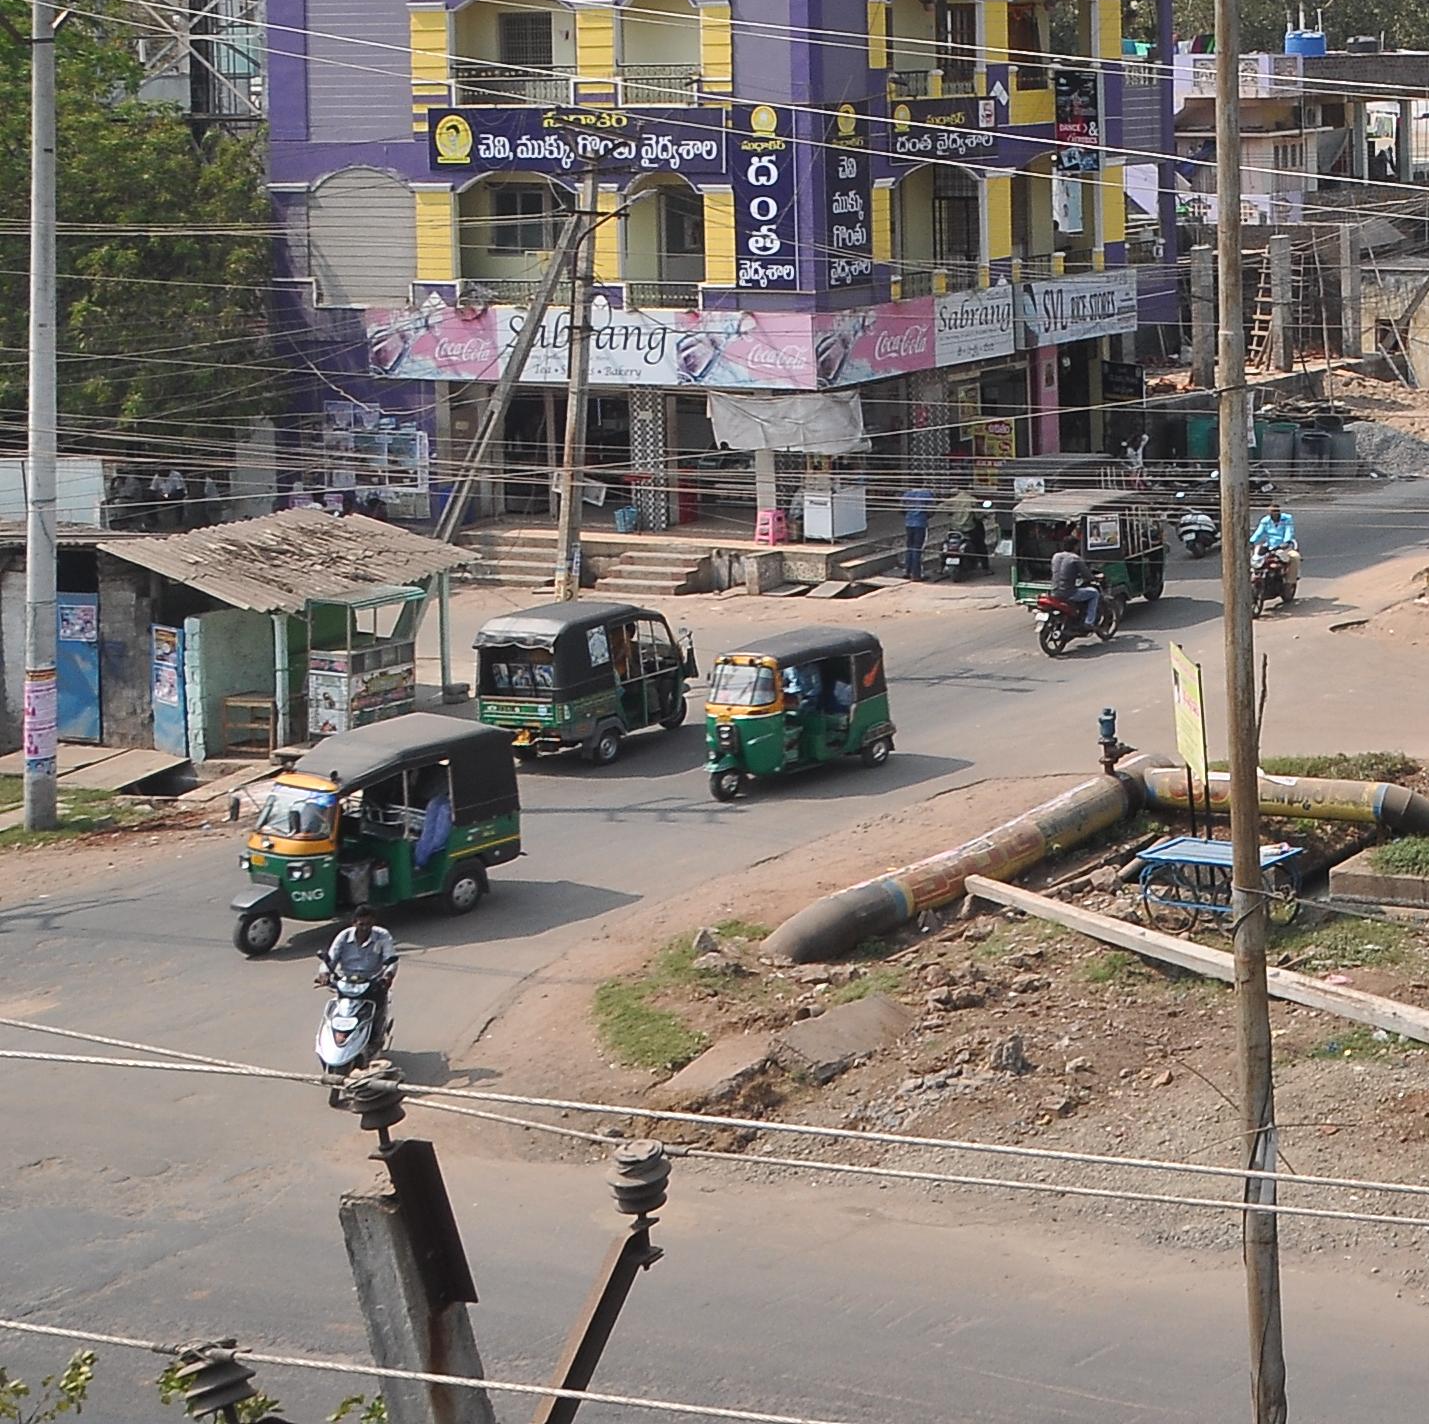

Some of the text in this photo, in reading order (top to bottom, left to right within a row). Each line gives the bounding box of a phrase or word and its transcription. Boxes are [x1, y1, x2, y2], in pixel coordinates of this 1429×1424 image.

[938, 298, 1011, 332] Sabrang
[507, 313, 668, 365] Sabang
[604, 366, 642, 378] Bakery
[291, 888, 325, 902] CNG
